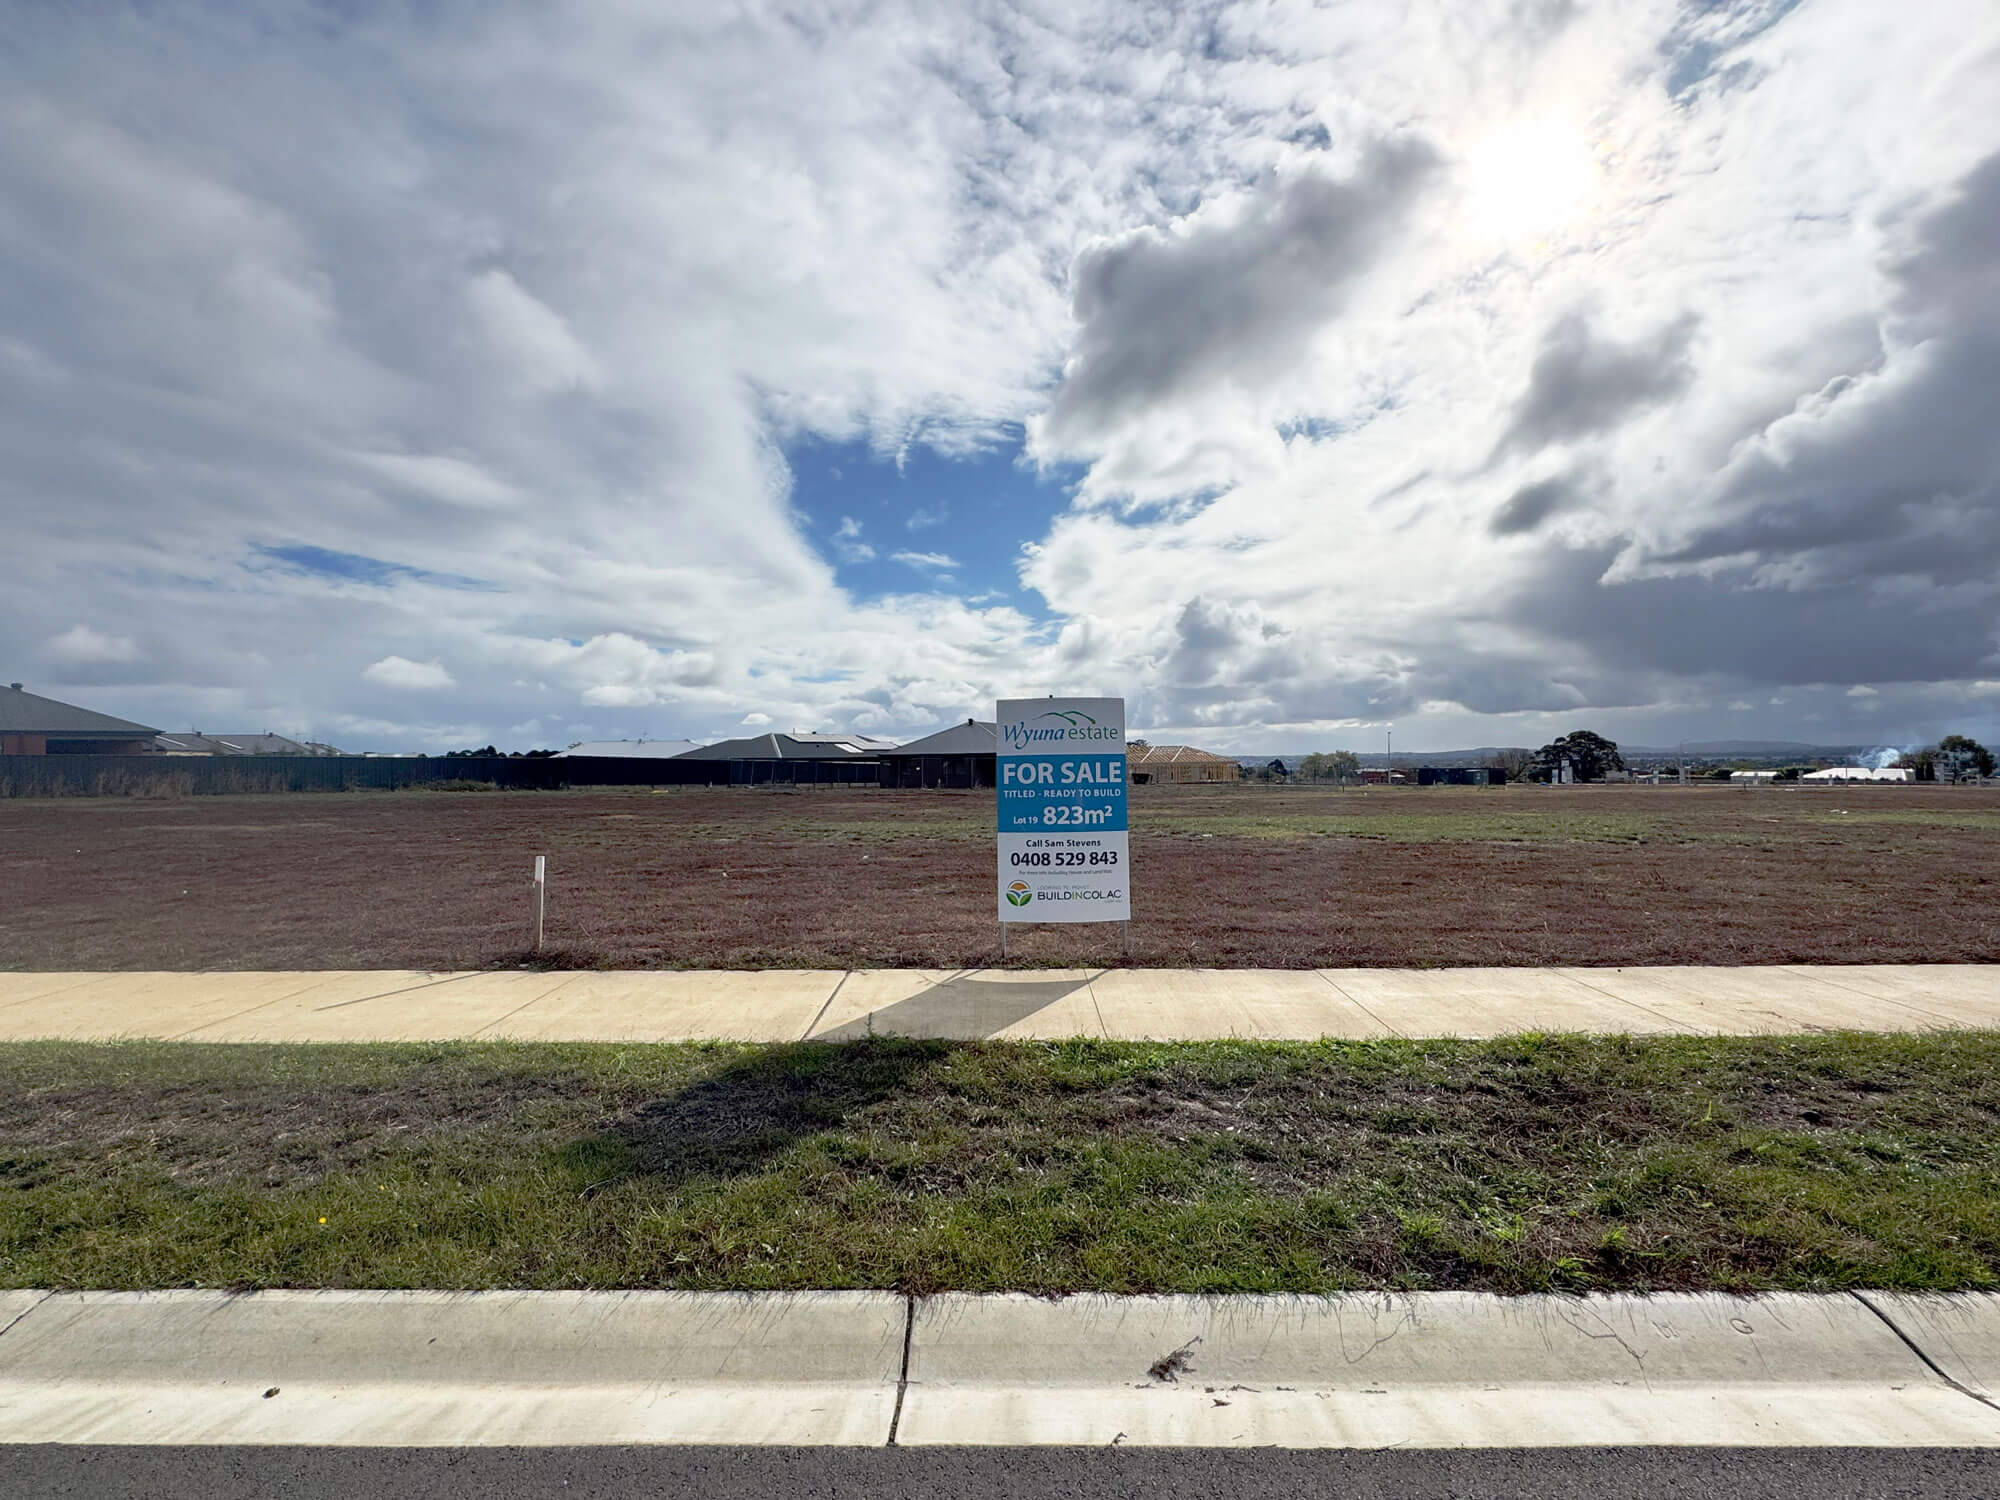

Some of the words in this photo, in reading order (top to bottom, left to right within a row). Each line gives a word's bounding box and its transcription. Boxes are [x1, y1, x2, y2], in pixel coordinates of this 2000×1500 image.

[1003, 721, 1065, 750] Wyuna
[1068, 725, 1118, 740] estate
[1003, 763, 1054, 784] FOR
[1061, 762, 1122, 783] SALE
[1003, 790, 1036, 798] TITLED
[1043, 789, 1077, 798] READY
[1080, 788, 1091, 797] TO
[1094, 788, 1121, 797] BUILD
[1013, 816, 1026, 825] Lot
[1028, 816, 1039, 825] 19
[1025, 839, 1043, 848] Call
[1045, 839, 1064, 847] Sam
[1066, 838, 1101, 847] Stevens
[1011, 852, 1051, 866] 0408
[1055, 852, 1085, 866] 529
[1089, 851, 1118, 865] 843
[1037, 889, 1122, 901] BUILDINCOLAC
